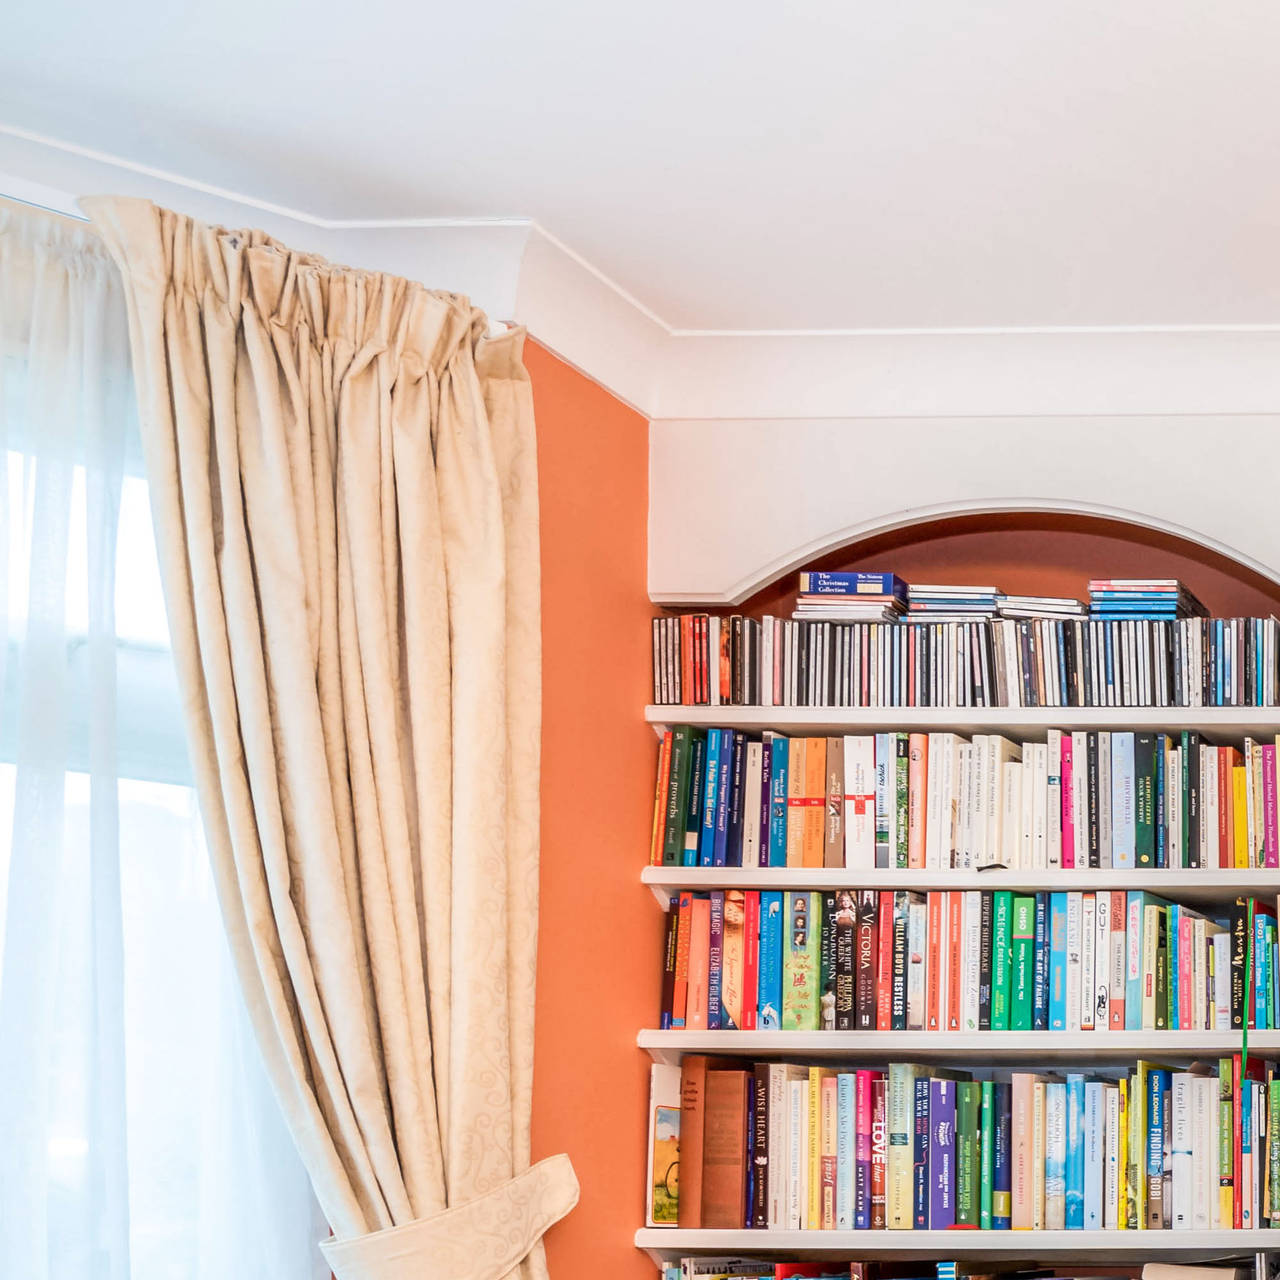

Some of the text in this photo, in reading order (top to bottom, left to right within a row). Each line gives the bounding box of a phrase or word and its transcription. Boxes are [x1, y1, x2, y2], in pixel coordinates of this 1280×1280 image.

[670, 782, 679, 818] proverbs
[877, 763, 885, 786] tschick
[710, 898, 720, 1015] BIG MAGIC ELIZABETH GILBERT
[822, 927, 828, 936] JO
[861, 914, 874, 969] VICTORIA
[1232, 918, 1244, 968] Mantra
[894, 918, 904, 1016] WILLIAM BOYD RESTLESS
[758, 1088, 766, 1148] WISE HEART
[1176, 1082, 1186, 1141] fragile lives
[872, 1122, 886, 1182] LOVE that
[1150, 1128, 1161, 1165] FINDING
[1150, 1178, 1161, 1200] GOBI
